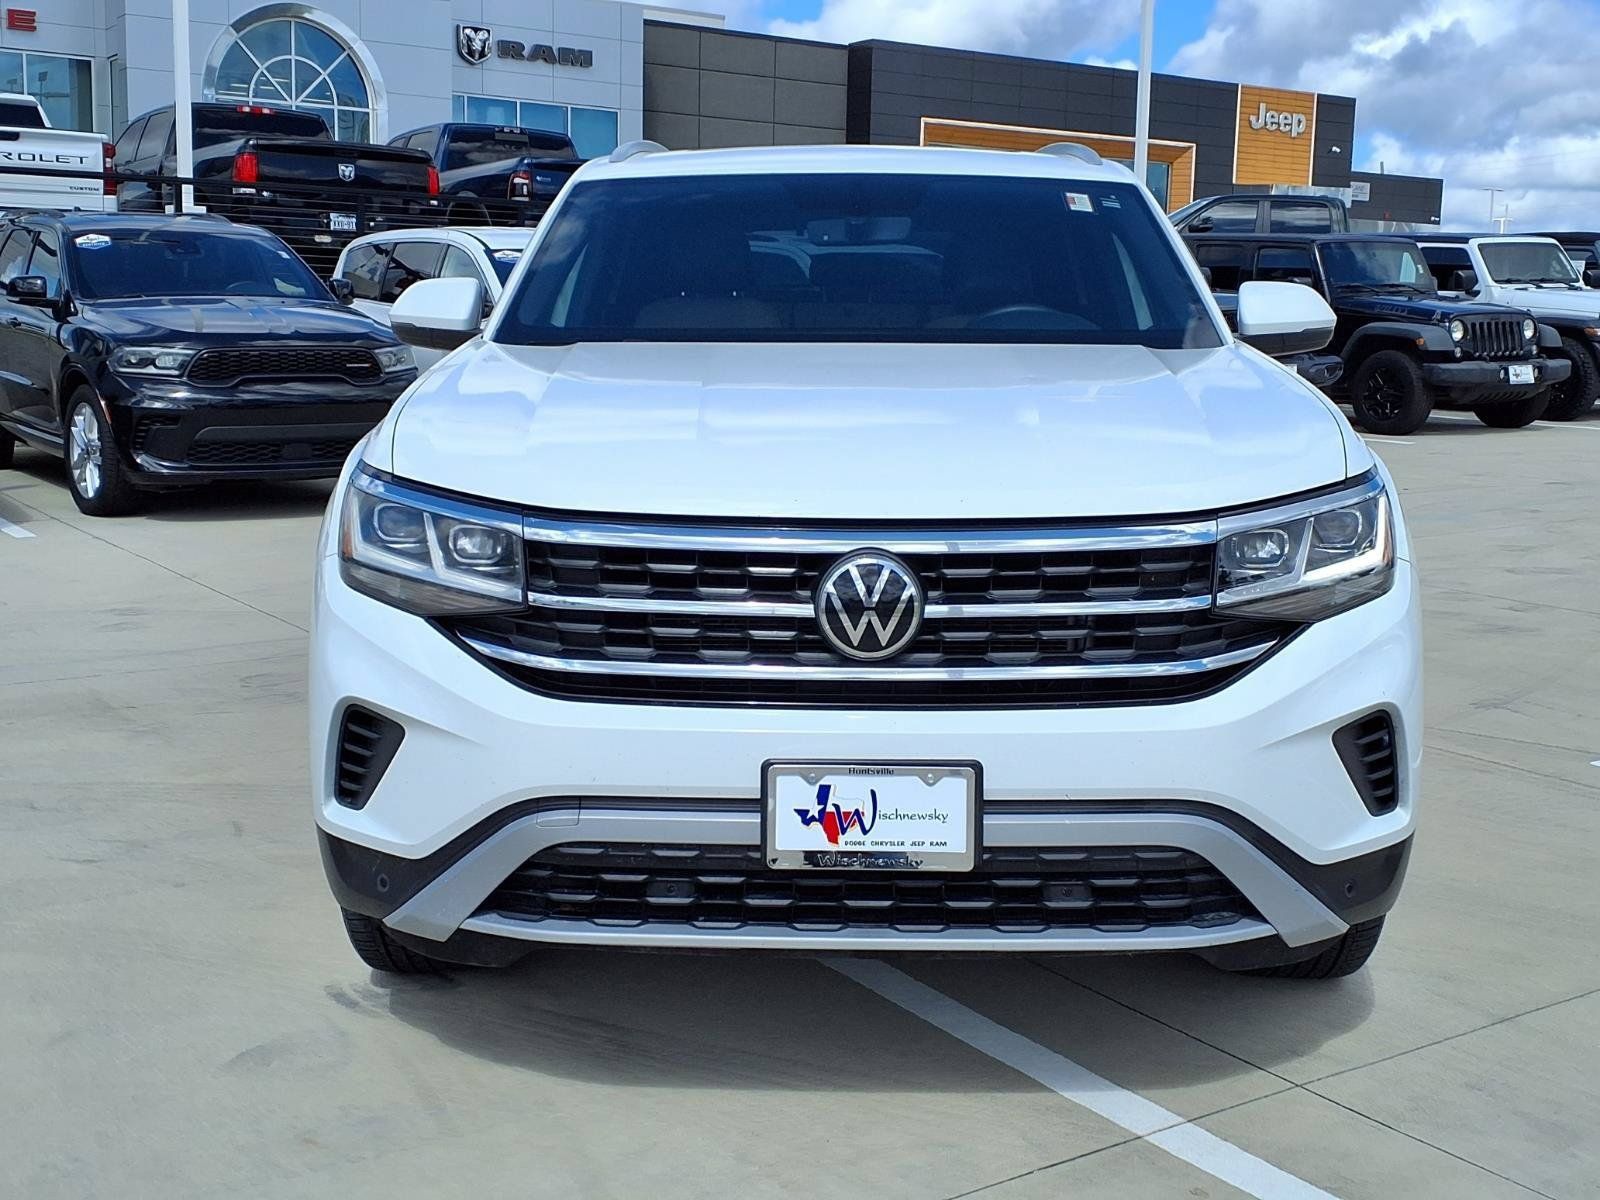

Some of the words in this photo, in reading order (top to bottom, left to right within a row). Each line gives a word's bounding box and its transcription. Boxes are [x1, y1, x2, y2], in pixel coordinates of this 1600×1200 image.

[6, 8, 37, 32] E
[497, 40, 593, 68] RAM
[1249, 102, 1307, 138] Jeep
[832, 788, 949, 836] Wischnewsky
